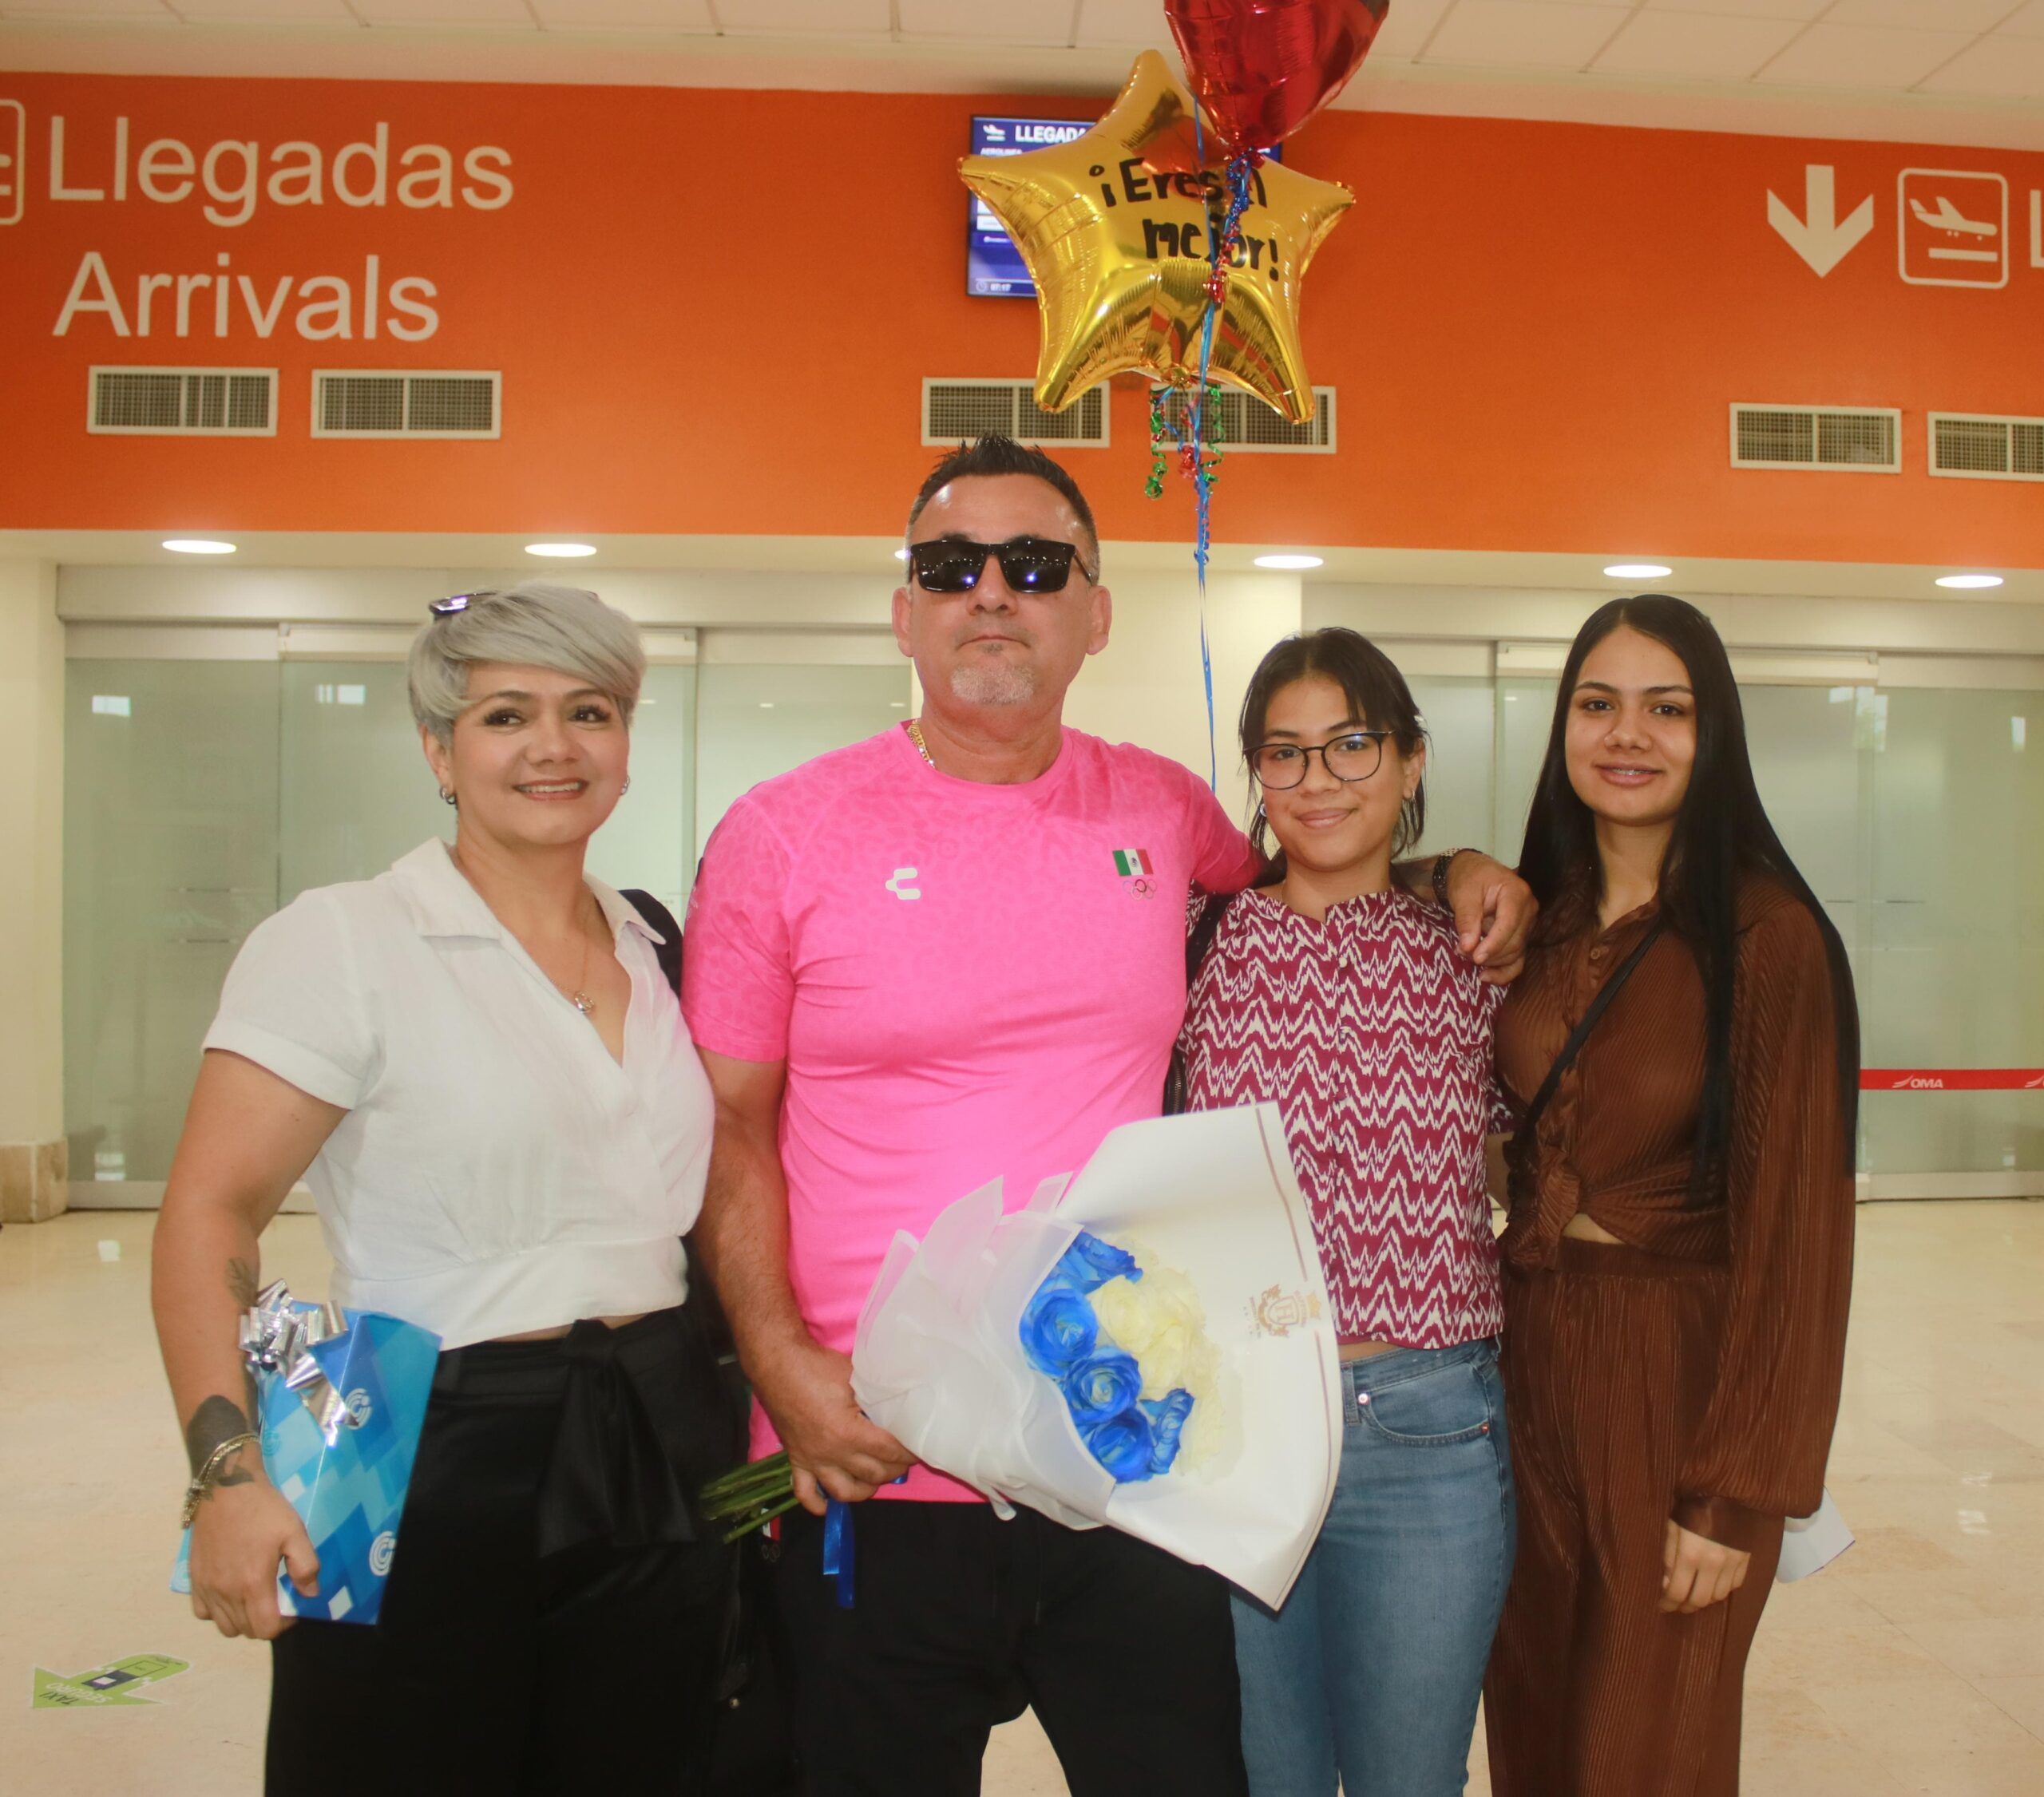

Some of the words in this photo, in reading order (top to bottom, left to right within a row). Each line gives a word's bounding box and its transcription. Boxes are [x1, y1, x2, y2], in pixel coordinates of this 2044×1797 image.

[50, 116, 513, 227] Llegadas
[1089, 157, 1223, 208] ¡Eres
[52, 251, 439, 342] Arrivals
[1910, 1079, 1943, 1089] OMA
[38, 1692, 80, 1705] TAXI
[46, 1682, 113, 1703] SEGURO
